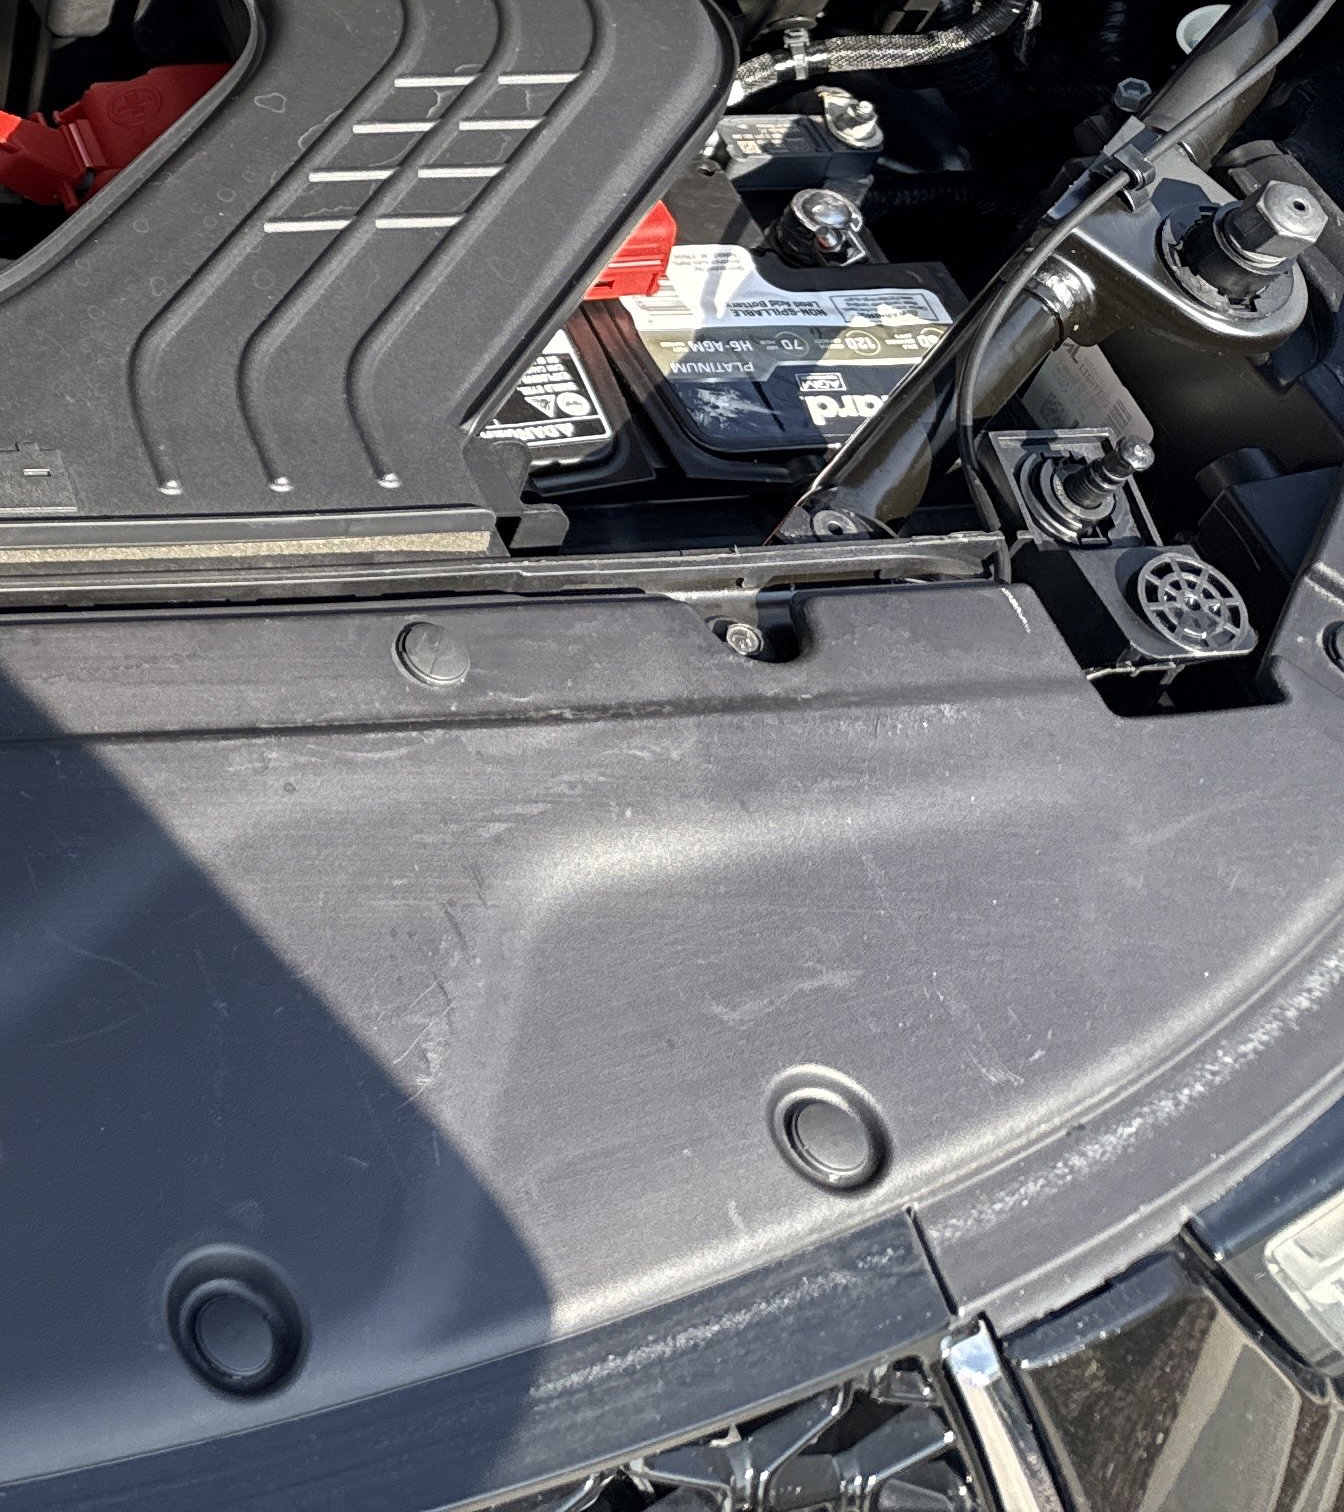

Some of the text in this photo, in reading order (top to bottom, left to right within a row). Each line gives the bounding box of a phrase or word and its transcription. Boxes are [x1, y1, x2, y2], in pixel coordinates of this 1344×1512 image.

[726, 300, 821, 309] Lead Acid Battery
[730, 308, 827, 317] NON-SPILLABLE
[688, 339, 753, 353] H6-AGM
[782, 338, 804, 351] 70
[844, 336, 877, 350] 120
[669, 360, 754, 374] PLATINUM
[800, 379, 840, 390] AGM
[804, 394, 888, 425] ard
